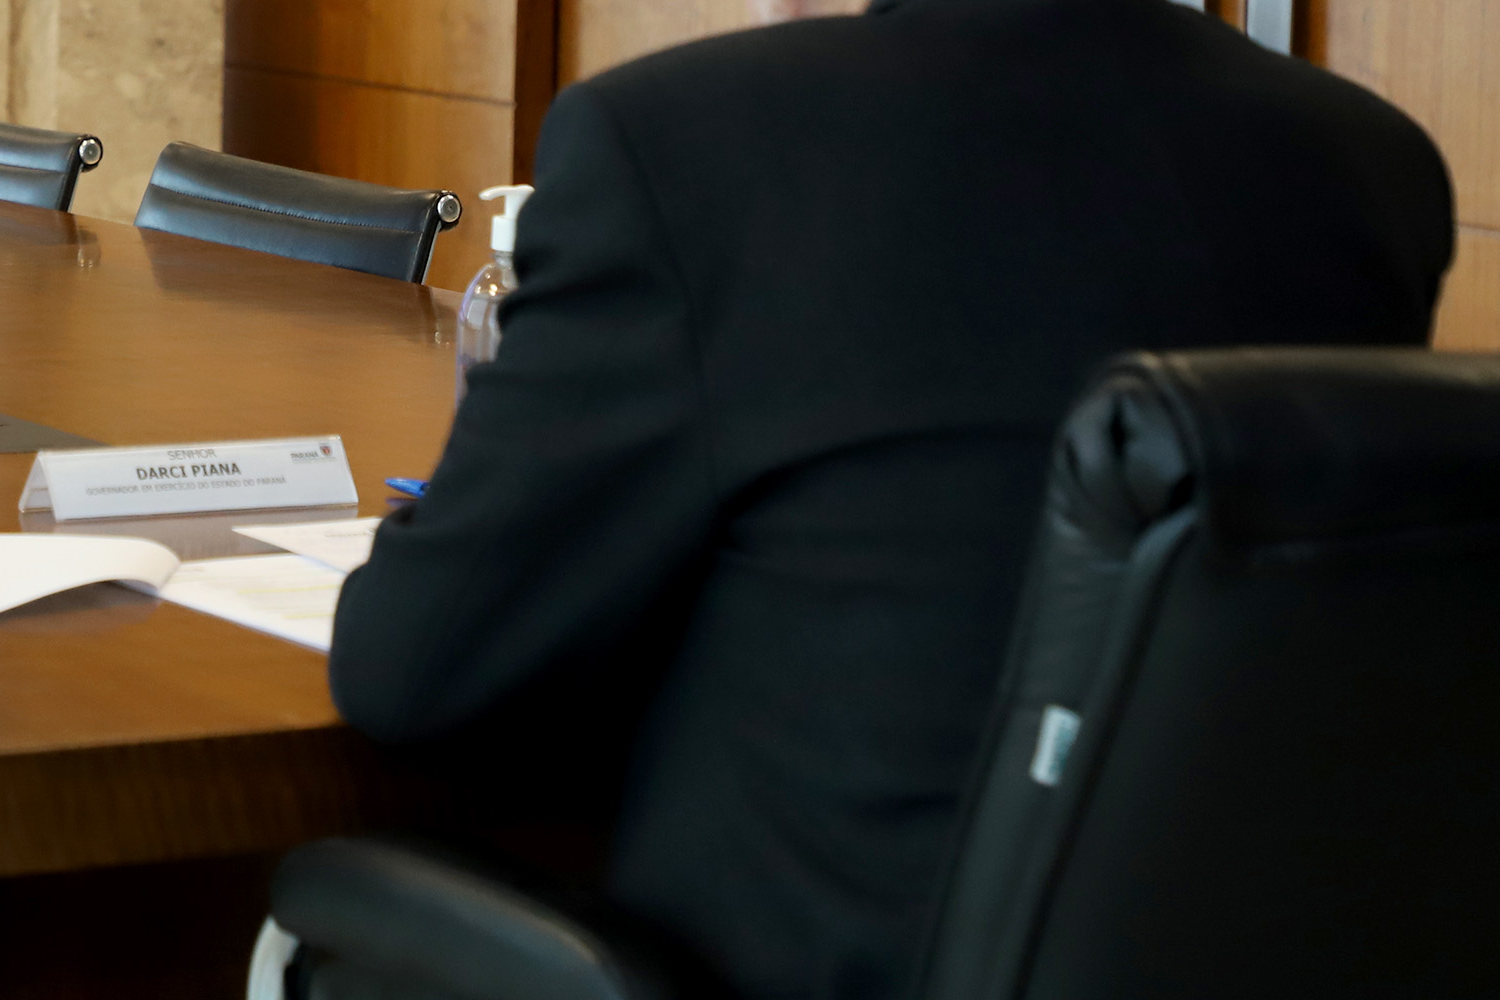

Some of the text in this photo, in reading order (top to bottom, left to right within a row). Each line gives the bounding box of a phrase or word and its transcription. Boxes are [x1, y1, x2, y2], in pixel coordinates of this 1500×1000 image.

[168, 449, 217, 461] SENHOR
[136, 463, 241, 480] DARCI PIANA
